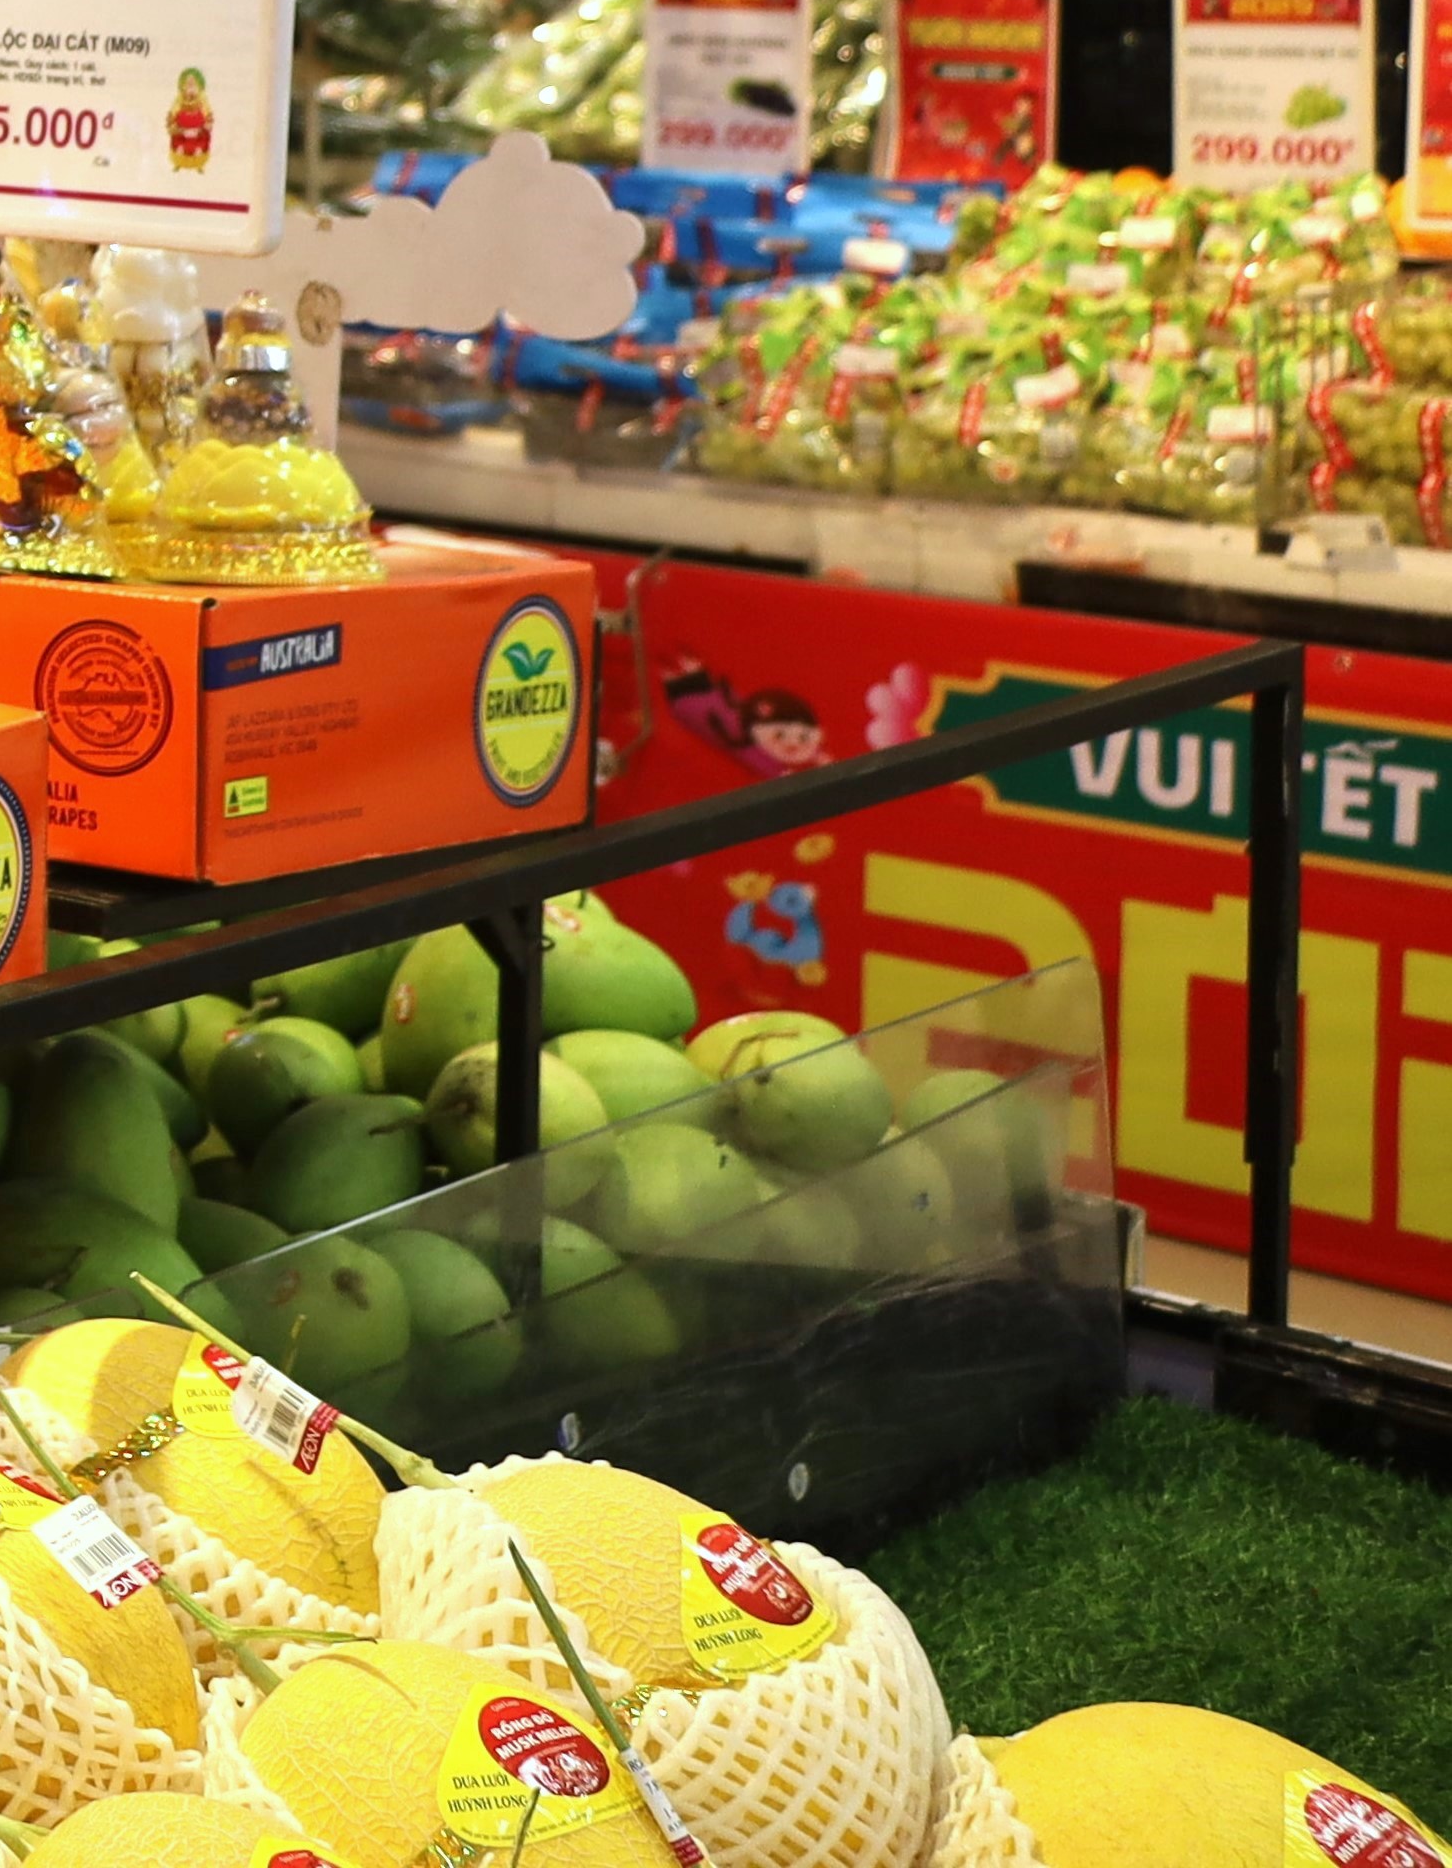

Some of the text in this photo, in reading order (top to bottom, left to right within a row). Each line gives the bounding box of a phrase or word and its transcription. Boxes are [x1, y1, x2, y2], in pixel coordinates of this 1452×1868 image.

[105, 37, 150, 57] (M09)
[486, 683, 567, 722] GRANDEZZA
[1068, 726, 1438, 850] VUI ẾT
[736, 1629, 763, 1642] LONG
[495, 1736, 538, 1760] MUSK
[496, 1795, 528, 1809] LONG
